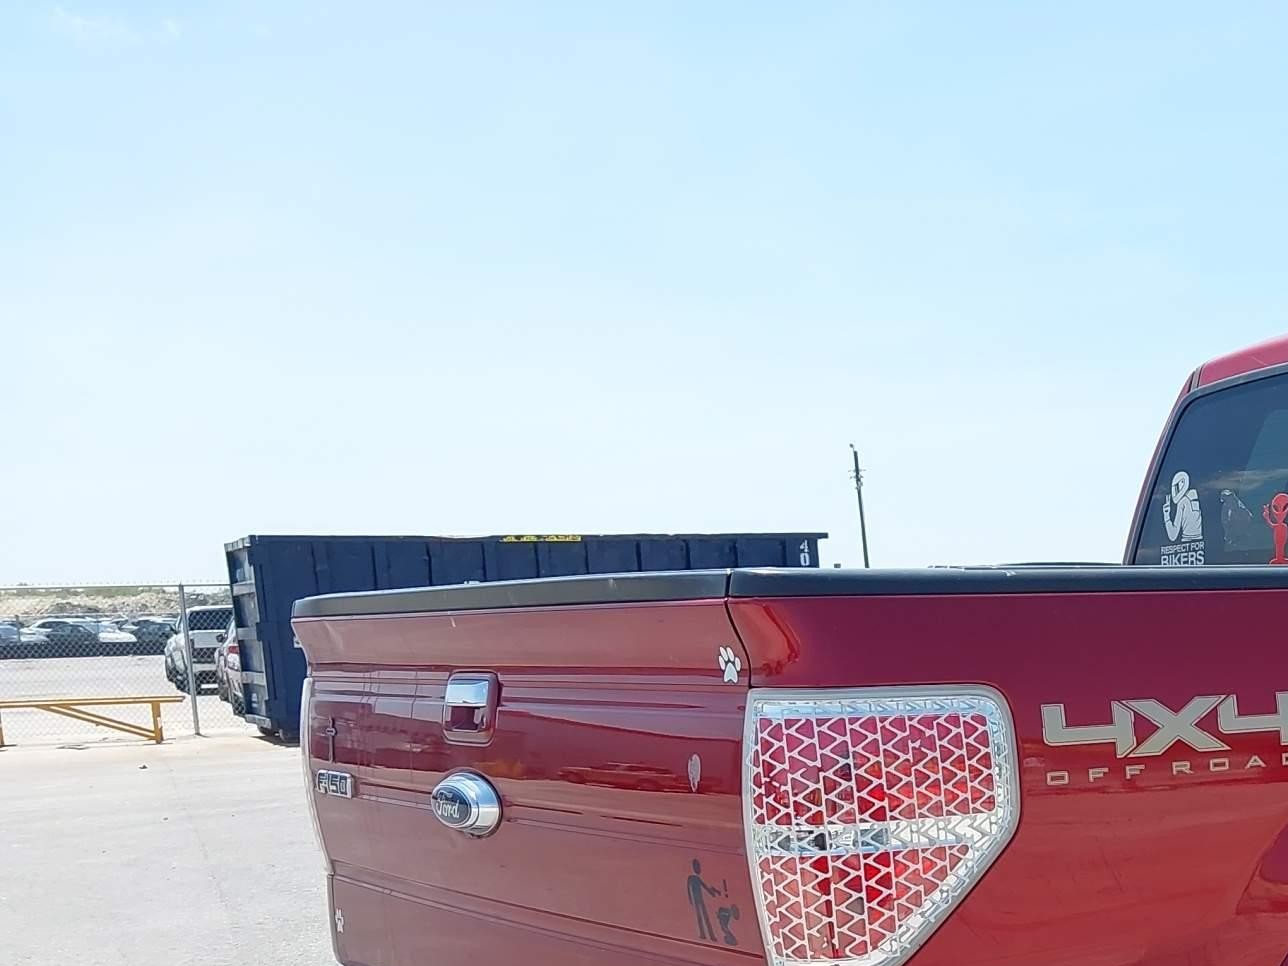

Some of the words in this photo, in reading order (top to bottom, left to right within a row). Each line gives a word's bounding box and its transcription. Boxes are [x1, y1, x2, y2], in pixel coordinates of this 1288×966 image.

[1160, 543, 1190, 555] RESPECT
[1191, 541, 1205, 551] FOR
[1161, 550, 1205, 566] BIKERS
[1046, 767, 1146, 786] OFF
[436, 790, 460, 818] Ford
